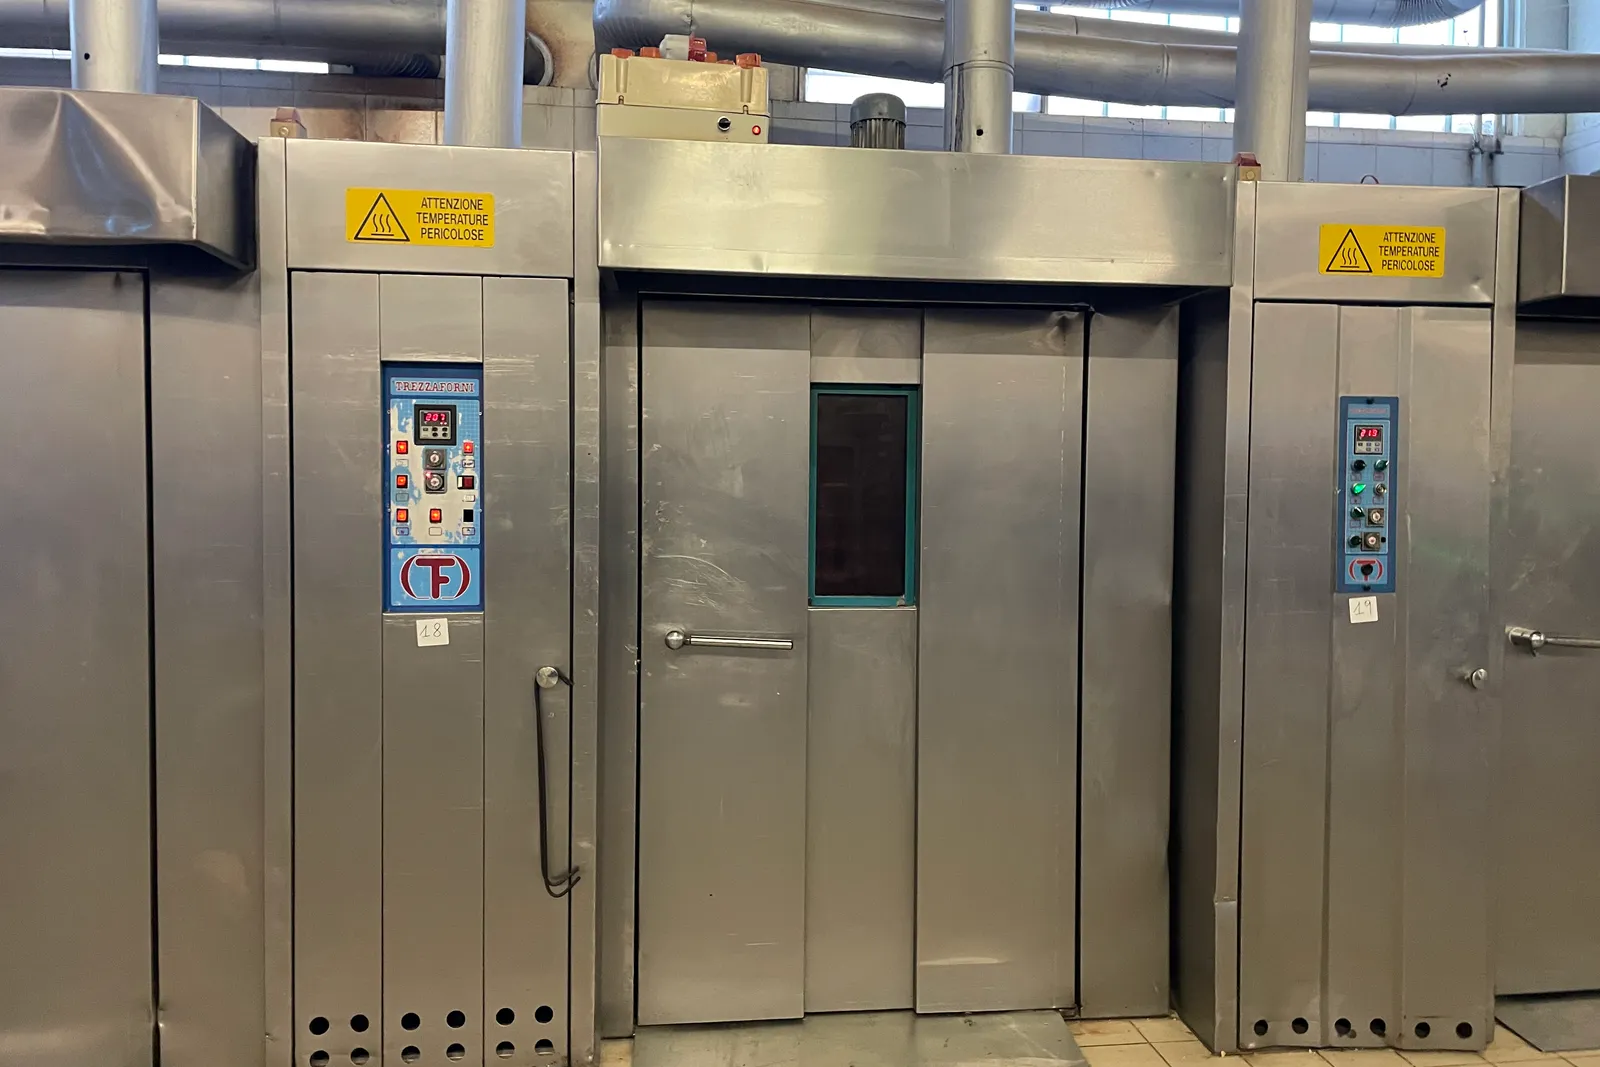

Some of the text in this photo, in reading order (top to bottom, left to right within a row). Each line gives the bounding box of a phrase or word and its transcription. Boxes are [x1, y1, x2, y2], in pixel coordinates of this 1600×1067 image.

[420, 197, 484, 211] ATTENZIONE
[416, 212, 489, 226] TEMPERATURE
[420, 227, 484, 241] PERICOLOSE
[1383, 232, 1436, 243] ATTENZIONE
[1379, 246, 1440, 257] TEMPERATURE
[1381, 260, 1435, 271] PERICOLOSE
[395, 381, 475, 393] TREZZAFORNI
[425, 413, 446, 421] 207
[1353, 600, 1372, 616] 19
[419, 622, 442, 638] 18
